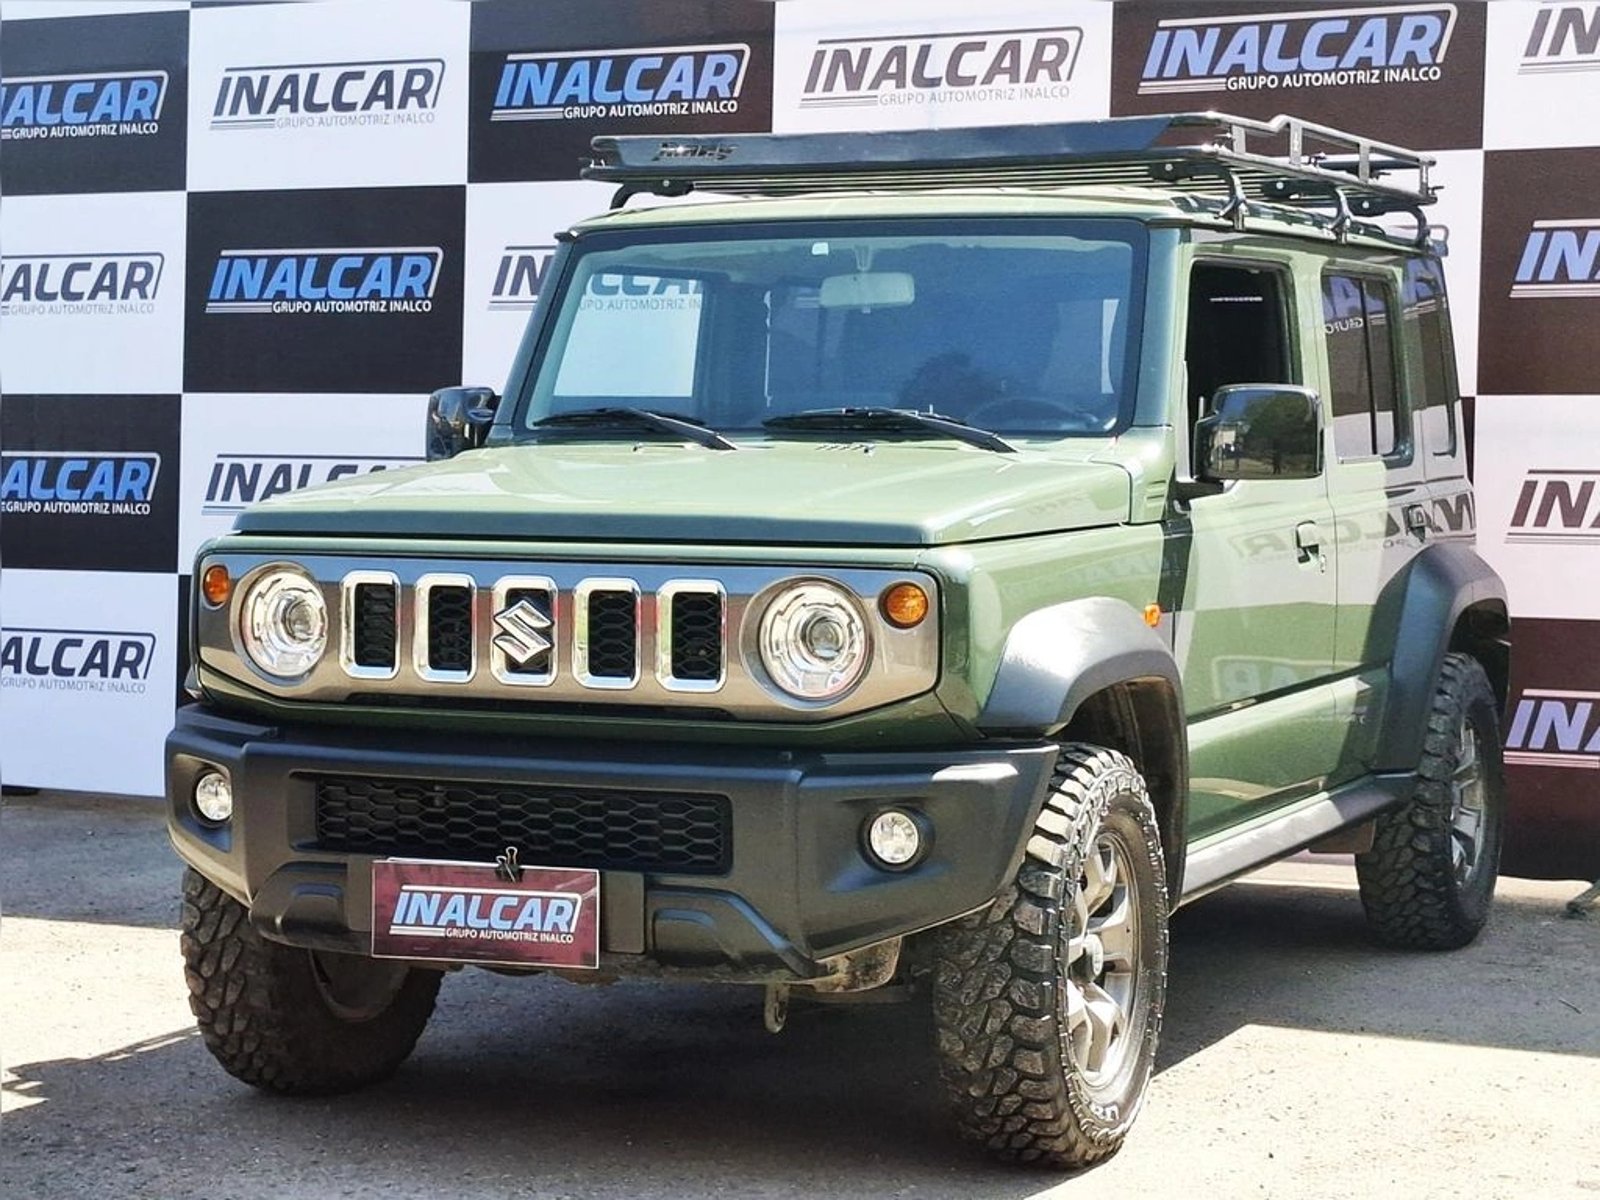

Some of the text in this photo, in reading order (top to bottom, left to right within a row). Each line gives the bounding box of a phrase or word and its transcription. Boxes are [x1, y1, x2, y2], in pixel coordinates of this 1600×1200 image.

[803, 36, 1070, 93] INALCAR
[1142, 14, 1443, 79] INALCAR
[213, 68, 435, 117] INALCAR
[495, 54, 739, 107] INALCAR
[879, 85, 1070, 106] GRUPO AUTOMOTRIZ INALCO
[1227, 66, 1441, 90] GRUPO AUTOMOTRIZ INALCO
[2, 79, 158, 126] ALCAR
[276, 112, 435, 130] GRUPO AUTOMOTRIZ INALCO
[564, 99, 738, 119] GRUPO AUTOMOTRIZ INALCO
[12, 122, 158, 139] GRUPO AUTOMOTRIZ INALCO
[1515, 230, 1600, 281] IN
[1, 261, 154, 302] ALCAR
[209, 255, 434, 299] INALCAR
[11, 303, 155, 315] GRUPO AUTOMOTRIZ INALCO
[272, 300, 432, 314] GRUPO AUTOMOTRIZ INALCO
[6, 501, 151, 515] GRUPO AUTOMOTRIZ INALCO
[1510, 480, 1600, 528] IN
[2, 677, 146, 694] GRUPO AUTOMOTRIZ INALCO
[1506, 700, 1600, 752] IN
[392, 891, 574, 931] INALCAR
[446, 927, 574, 944] GRUPO AUTOMOTRIZ INALCO
